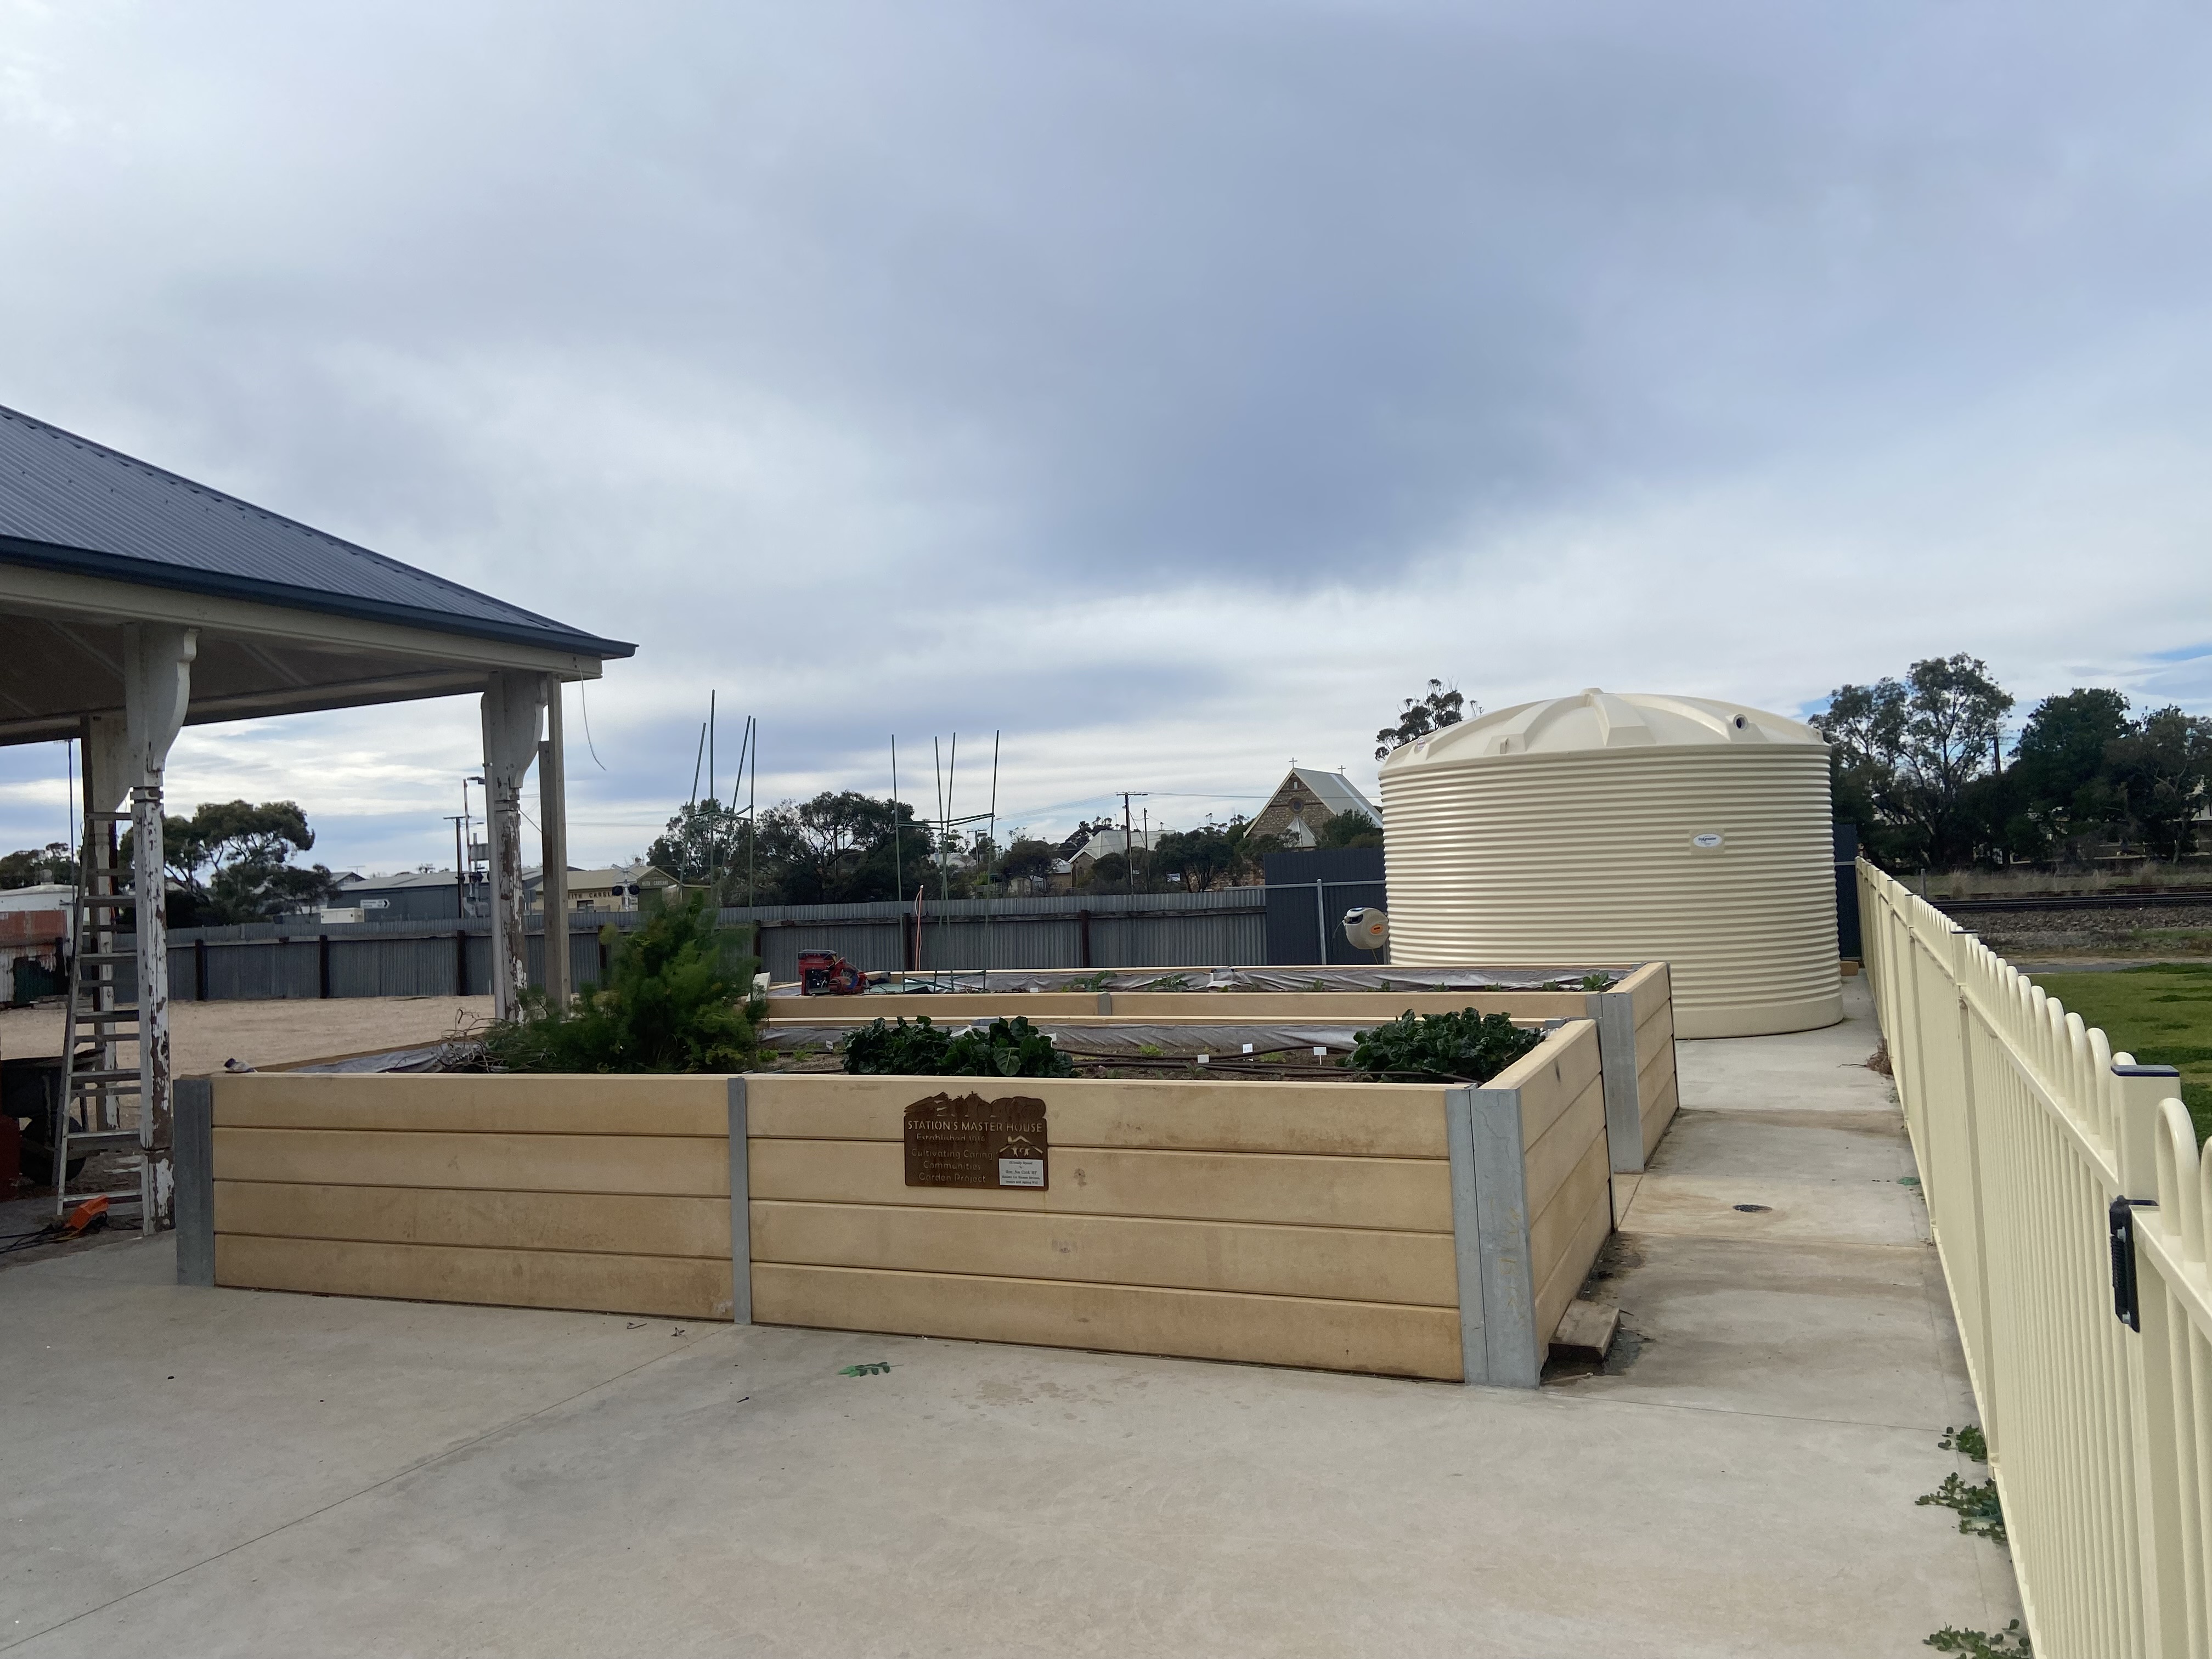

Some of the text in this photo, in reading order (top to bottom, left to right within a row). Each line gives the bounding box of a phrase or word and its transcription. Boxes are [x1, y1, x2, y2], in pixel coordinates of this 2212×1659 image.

[962, 1122, 1002, 1132] MASTER
[1007, 1123, 1042, 1132] HOUSE
[917, 1133, 966, 1142] Established
[912, 1148, 993, 1160] Cultivating Caring
[923, 1160, 981, 1170] Communities
[919, 1172, 986, 1183] Garden Project
